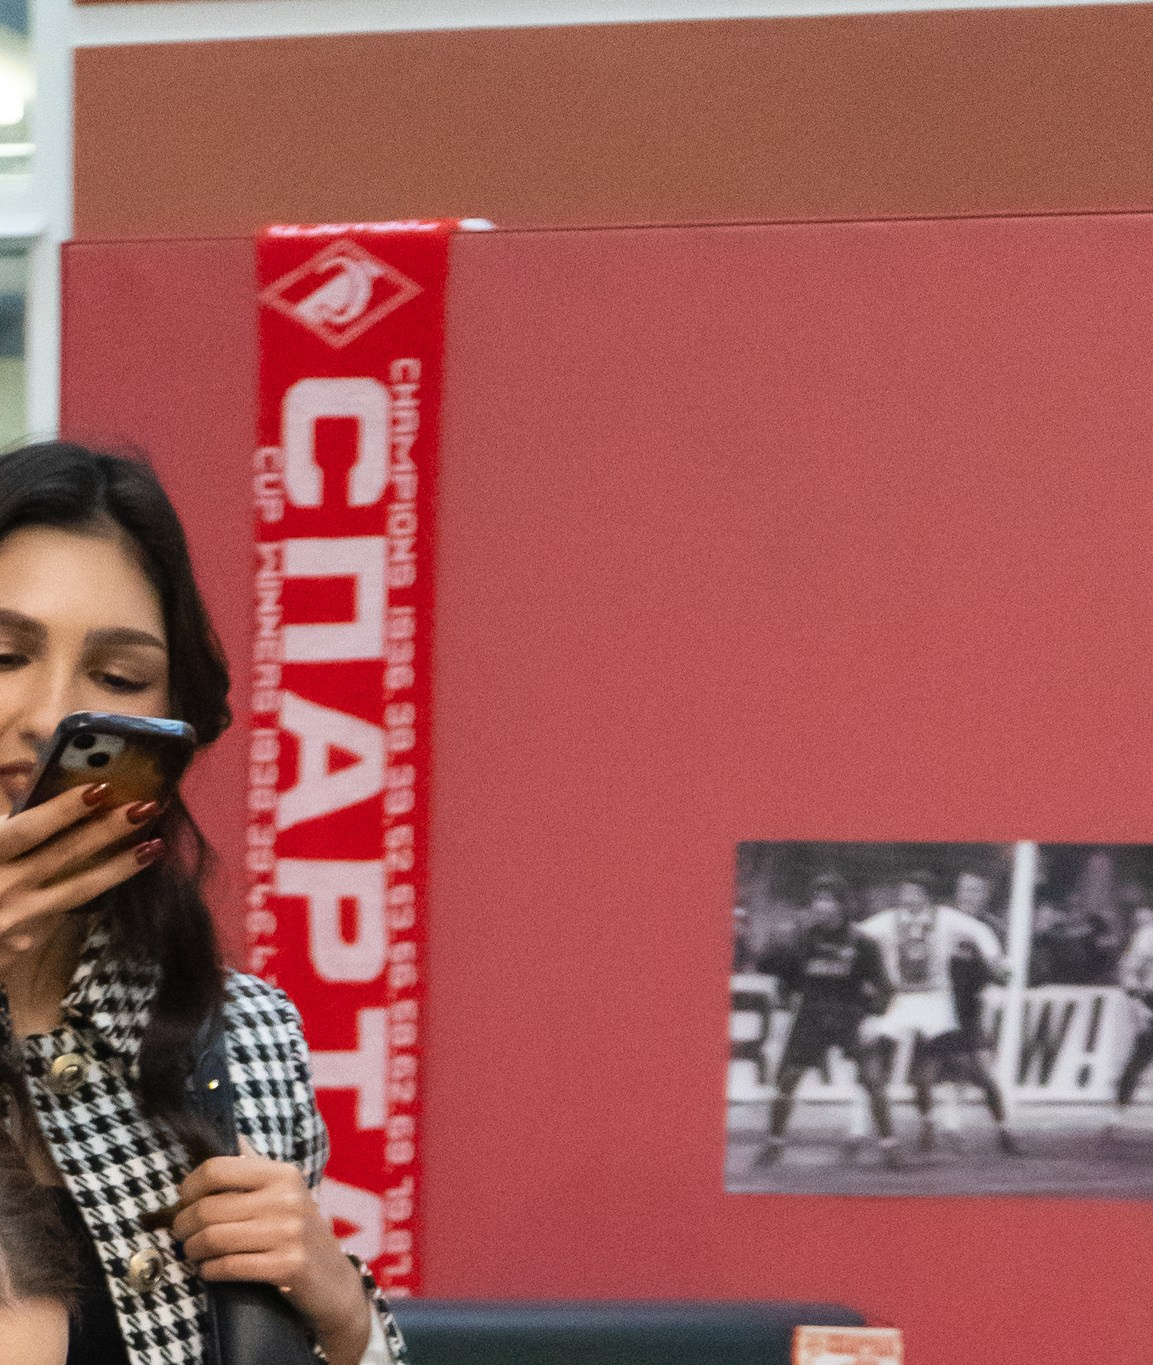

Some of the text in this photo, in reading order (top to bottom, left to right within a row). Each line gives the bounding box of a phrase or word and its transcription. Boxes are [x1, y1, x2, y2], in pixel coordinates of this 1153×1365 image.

[253, 446, 286, 523] CUP
[387, 358, 422, 588] CHAMPIONS
[251, 543, 285, 712] WINNERS
[277, 377, 389, 1262] СПАРТА
